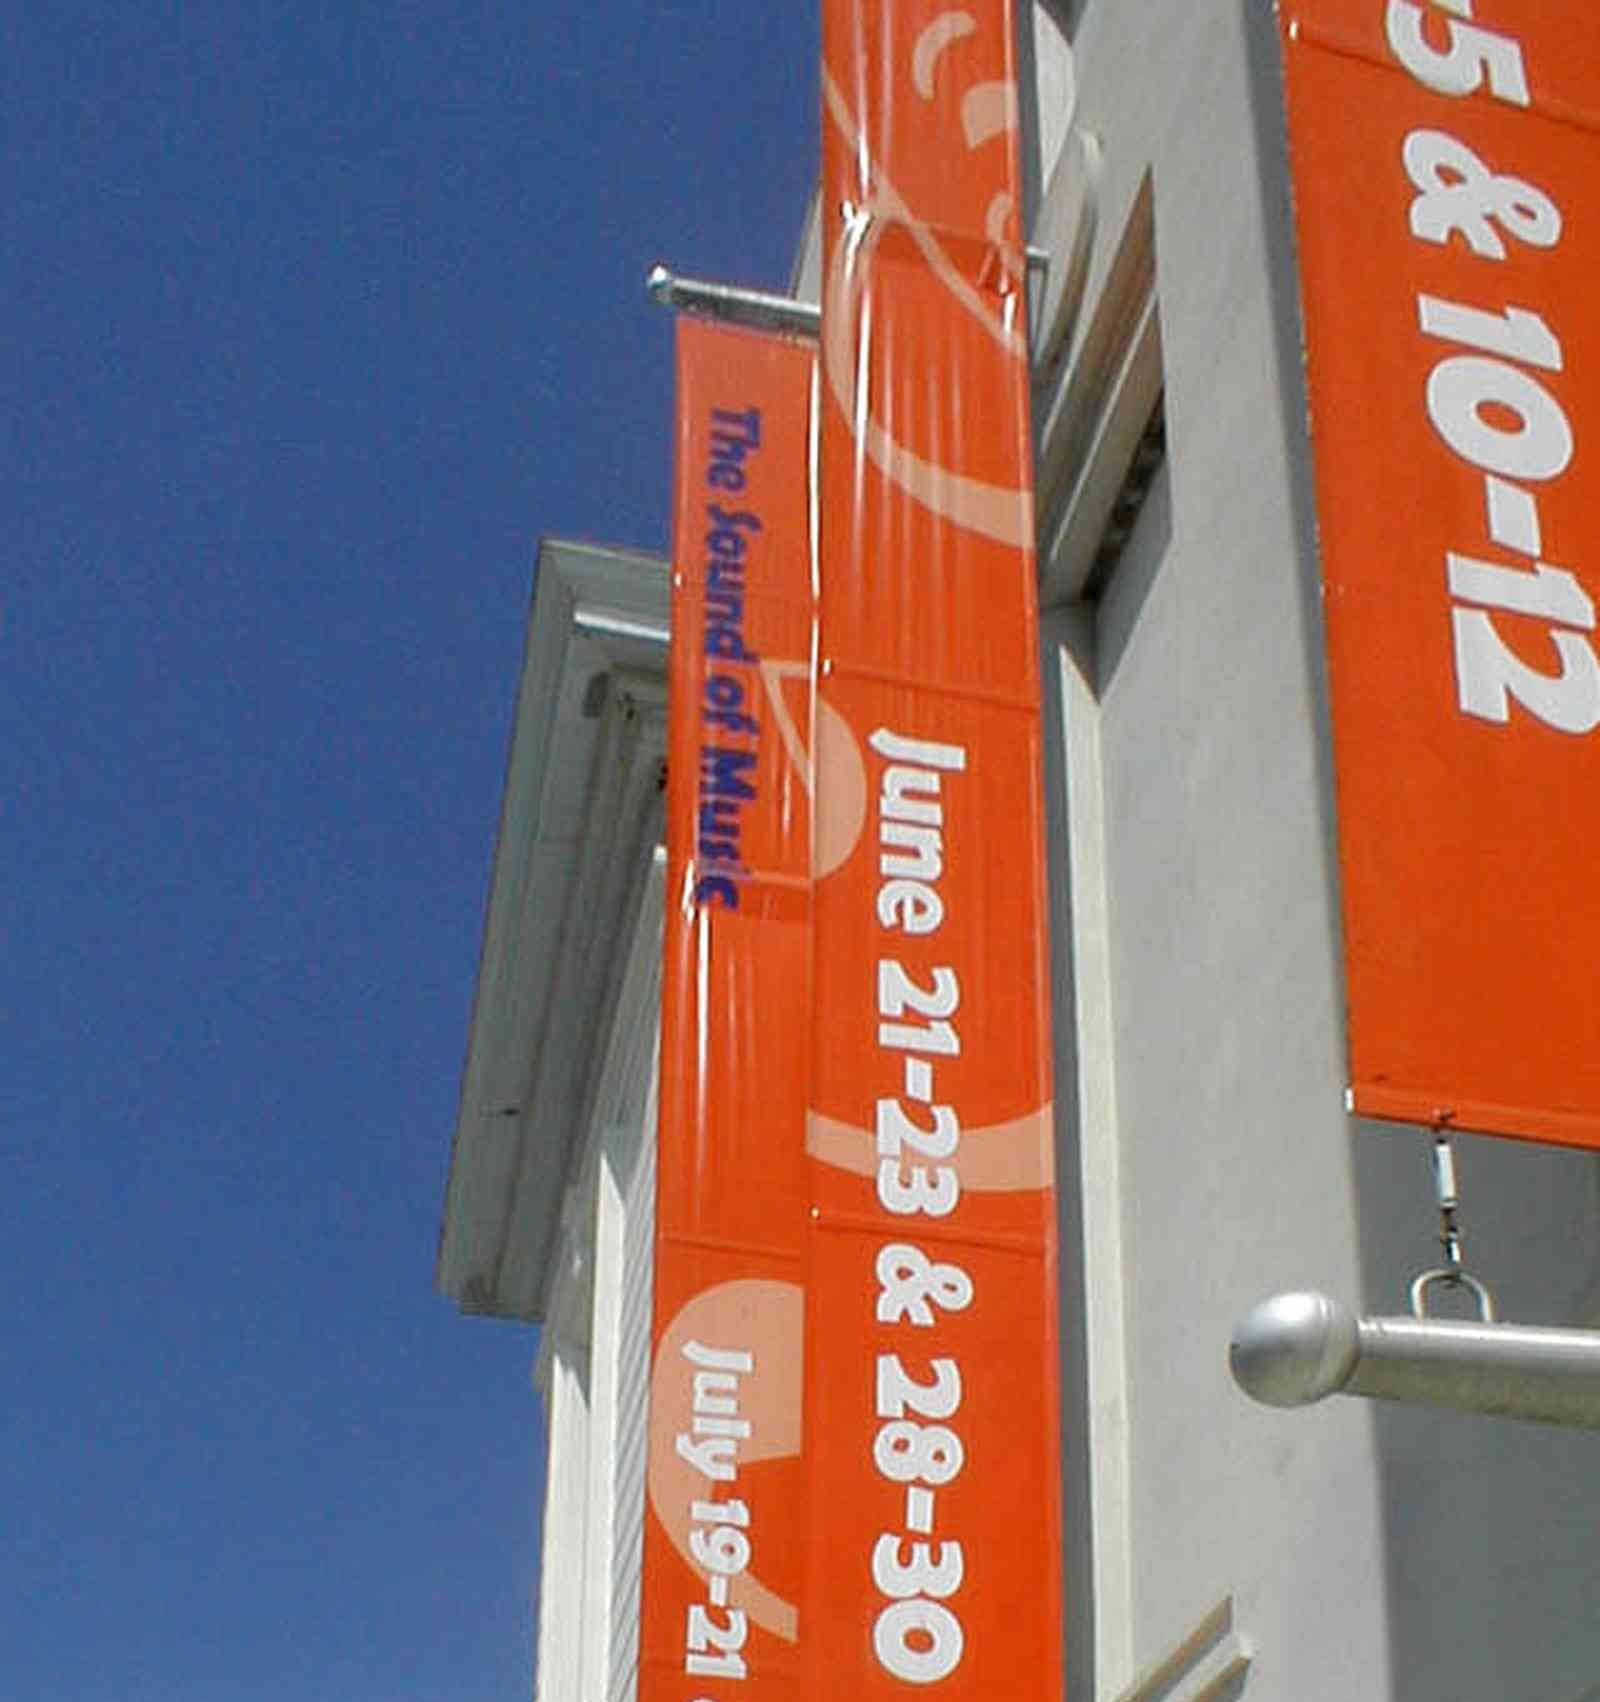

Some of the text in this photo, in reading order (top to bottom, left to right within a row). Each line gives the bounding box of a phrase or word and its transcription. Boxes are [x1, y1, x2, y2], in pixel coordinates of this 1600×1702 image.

[1385, 0, 1600, 735] 5 & 10-12
[692, 406, 762, 912] The Sound of Music
[675, 1339, 754, 1481] July
[868, 728, 974, 1684] June 21-23 & 28-30
[685, 1499, 751, 1680] 19-21
